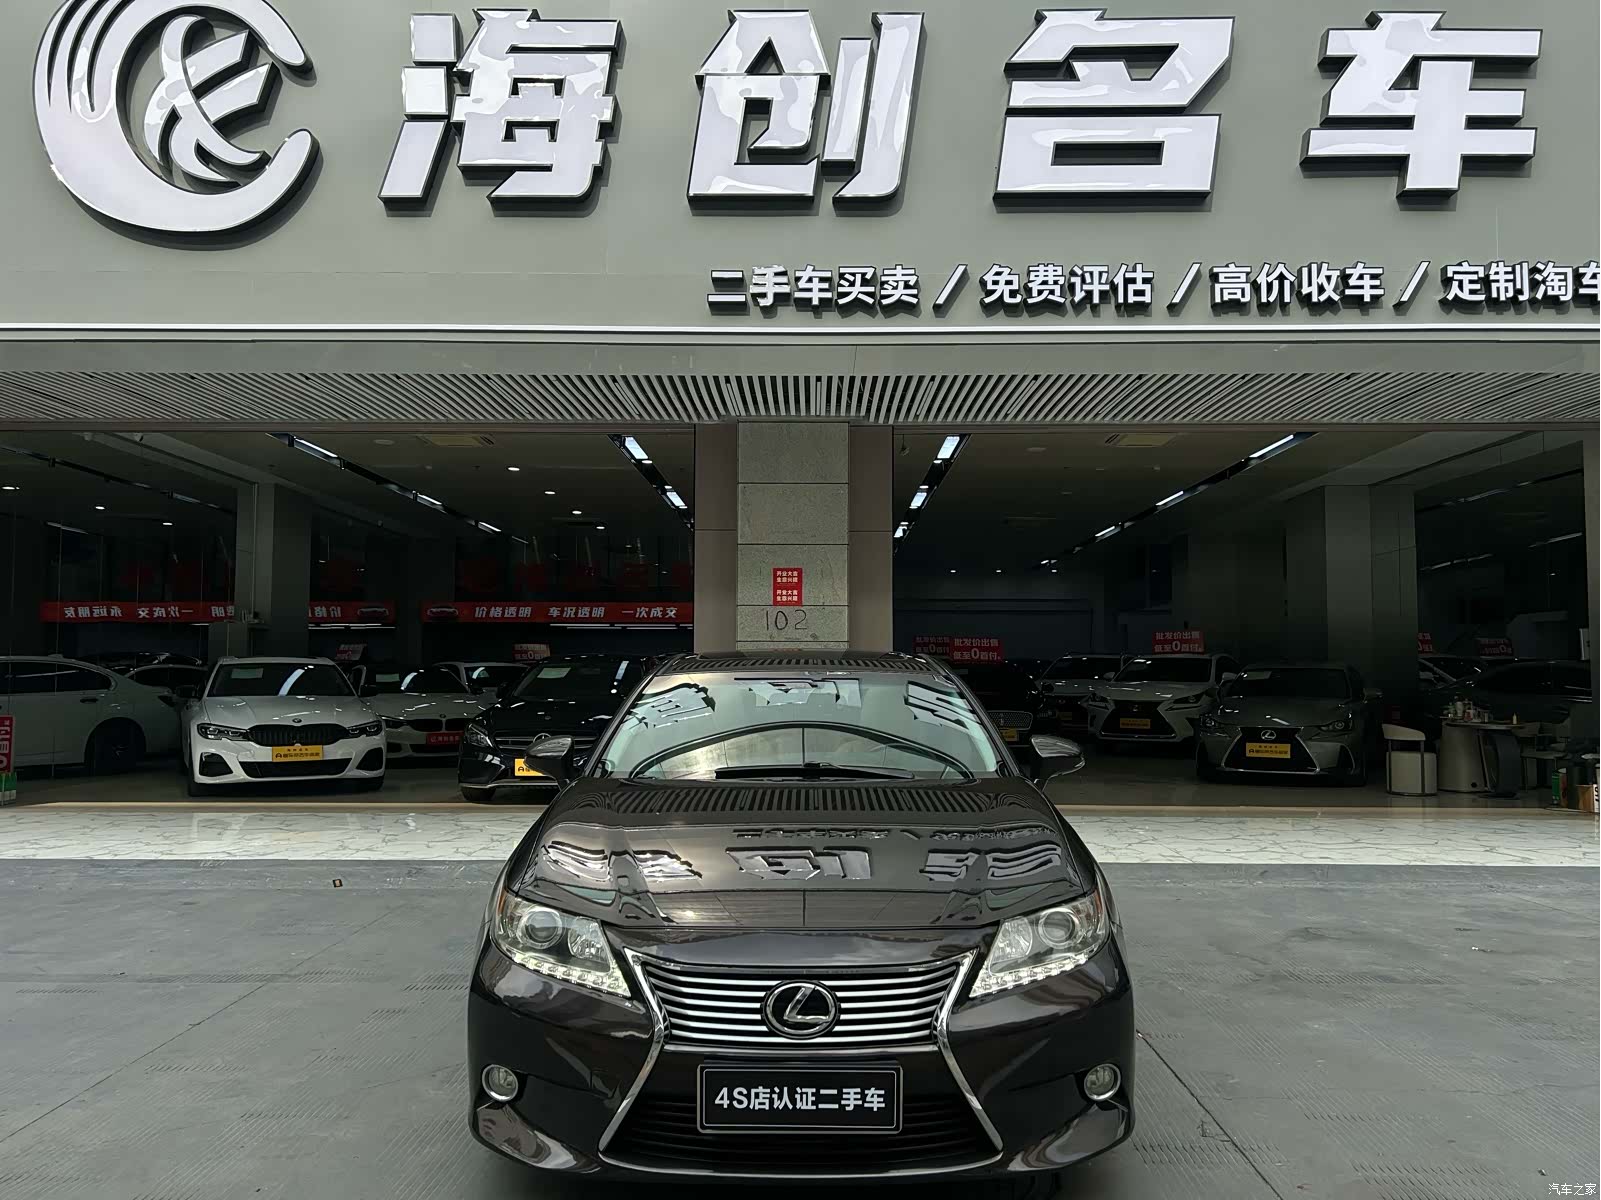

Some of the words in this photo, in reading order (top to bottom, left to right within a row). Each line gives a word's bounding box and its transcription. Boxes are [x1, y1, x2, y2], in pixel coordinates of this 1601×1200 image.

[379, 7, 1544, 207] 海创名车
[707, 264, 919, 307] 二手车买卖
[982, 263, 1155, 304] 免费评估
[1211, 262, 1385, 304] 高价收车
[474, 606, 533, 618] 价格透明
[547, 606, 606, 618] 车况透明
[621, 606, 678, 618] 一次成交
[766, 609, 807, 630] 102
[714, 1086, 886, 1111] 4S店认证二手车
